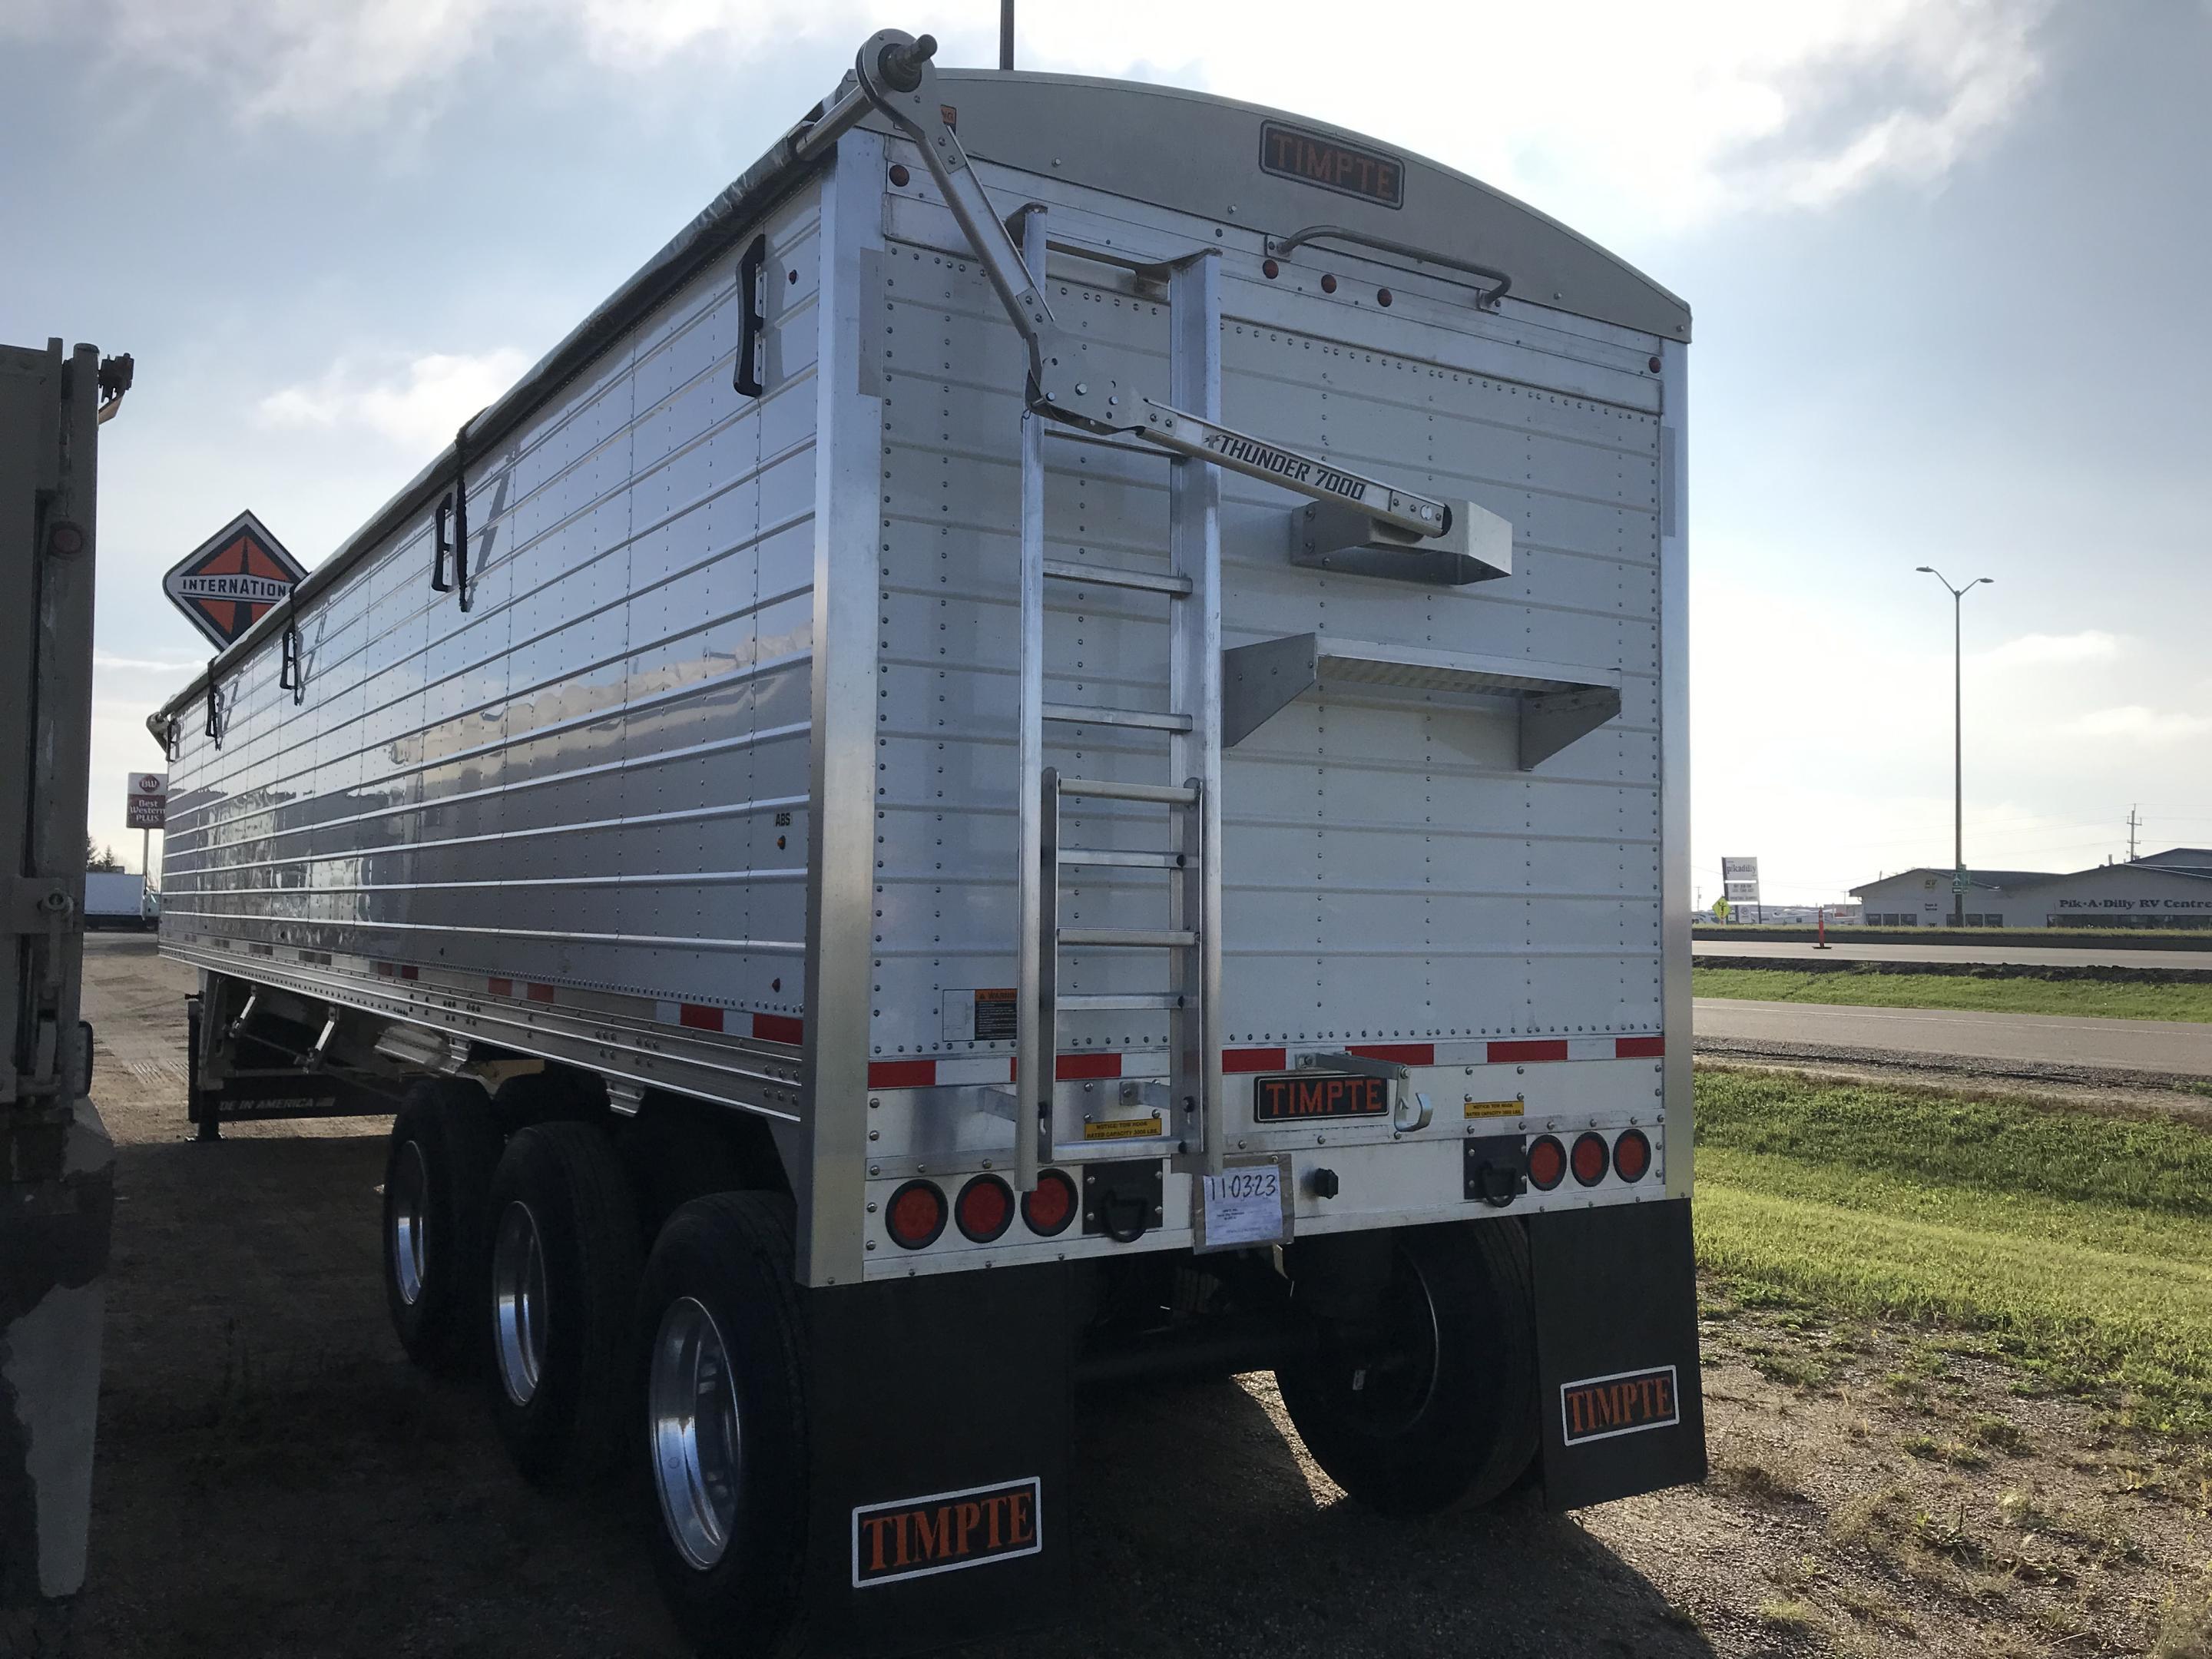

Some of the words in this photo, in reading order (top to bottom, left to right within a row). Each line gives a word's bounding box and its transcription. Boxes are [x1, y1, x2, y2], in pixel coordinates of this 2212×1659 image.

[1273, 134, 1395, 198] TIMPTE
[1220, 435, 1310, 482] THUNDER
[1314, 469, 1366, 500] 7000
[183, 578, 287, 597] INTERNATION
[130, 806, 166, 814] Western
[775, 813, 790, 826] ABS
[2139, 899, 2160, 908] RV
[219, 1100, 235, 1111] DE
[239, 1099, 255, 1110] IN
[256, 1098, 314, 1109] AMERICA
[1265, 1079, 1382, 1114] TIMPTE
[1567, 1376, 1673, 1432] TIMPTE
[863, 1492, 1034, 1571] TIMPTE
